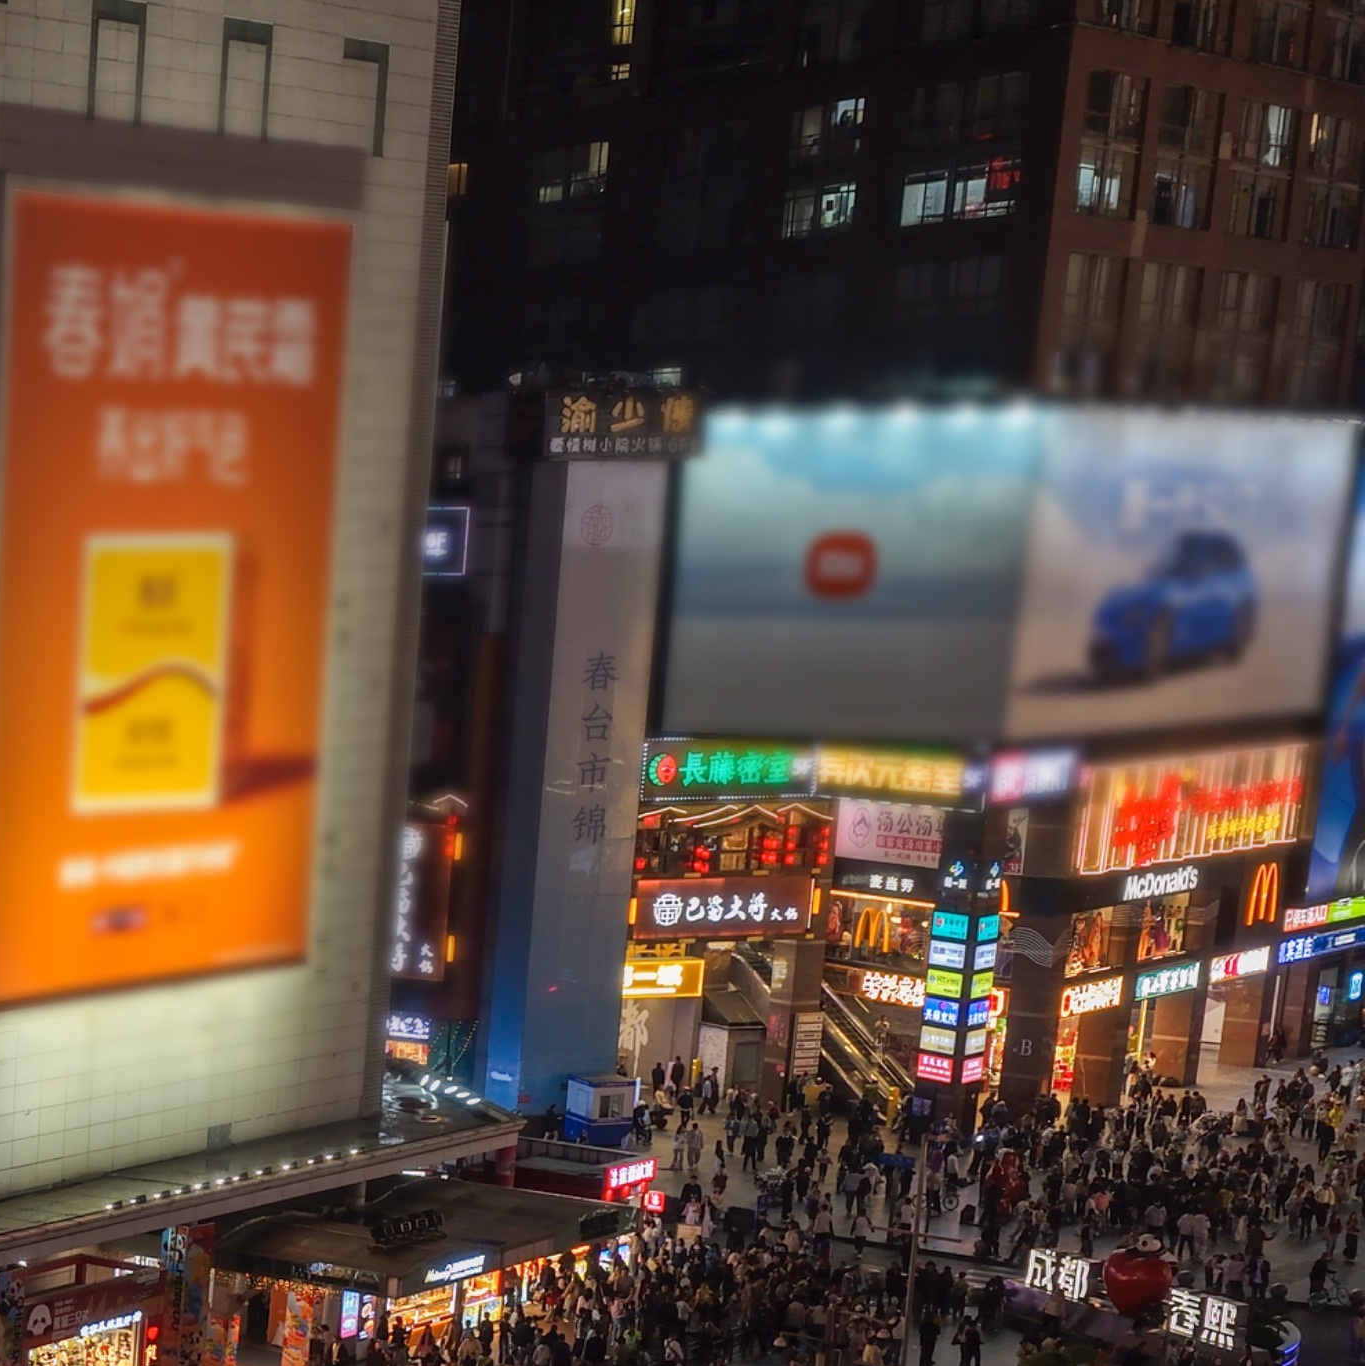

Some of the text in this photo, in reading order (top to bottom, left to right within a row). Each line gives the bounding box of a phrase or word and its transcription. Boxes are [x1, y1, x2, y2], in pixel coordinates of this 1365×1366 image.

[572, 651, 619, 842] 春台市锦
[869, 874, 915, 893] 麦当劳
[1124, 864, 1199, 902] McDonald's
[1024, 1248, 1238, 1352] 成都 春熙
